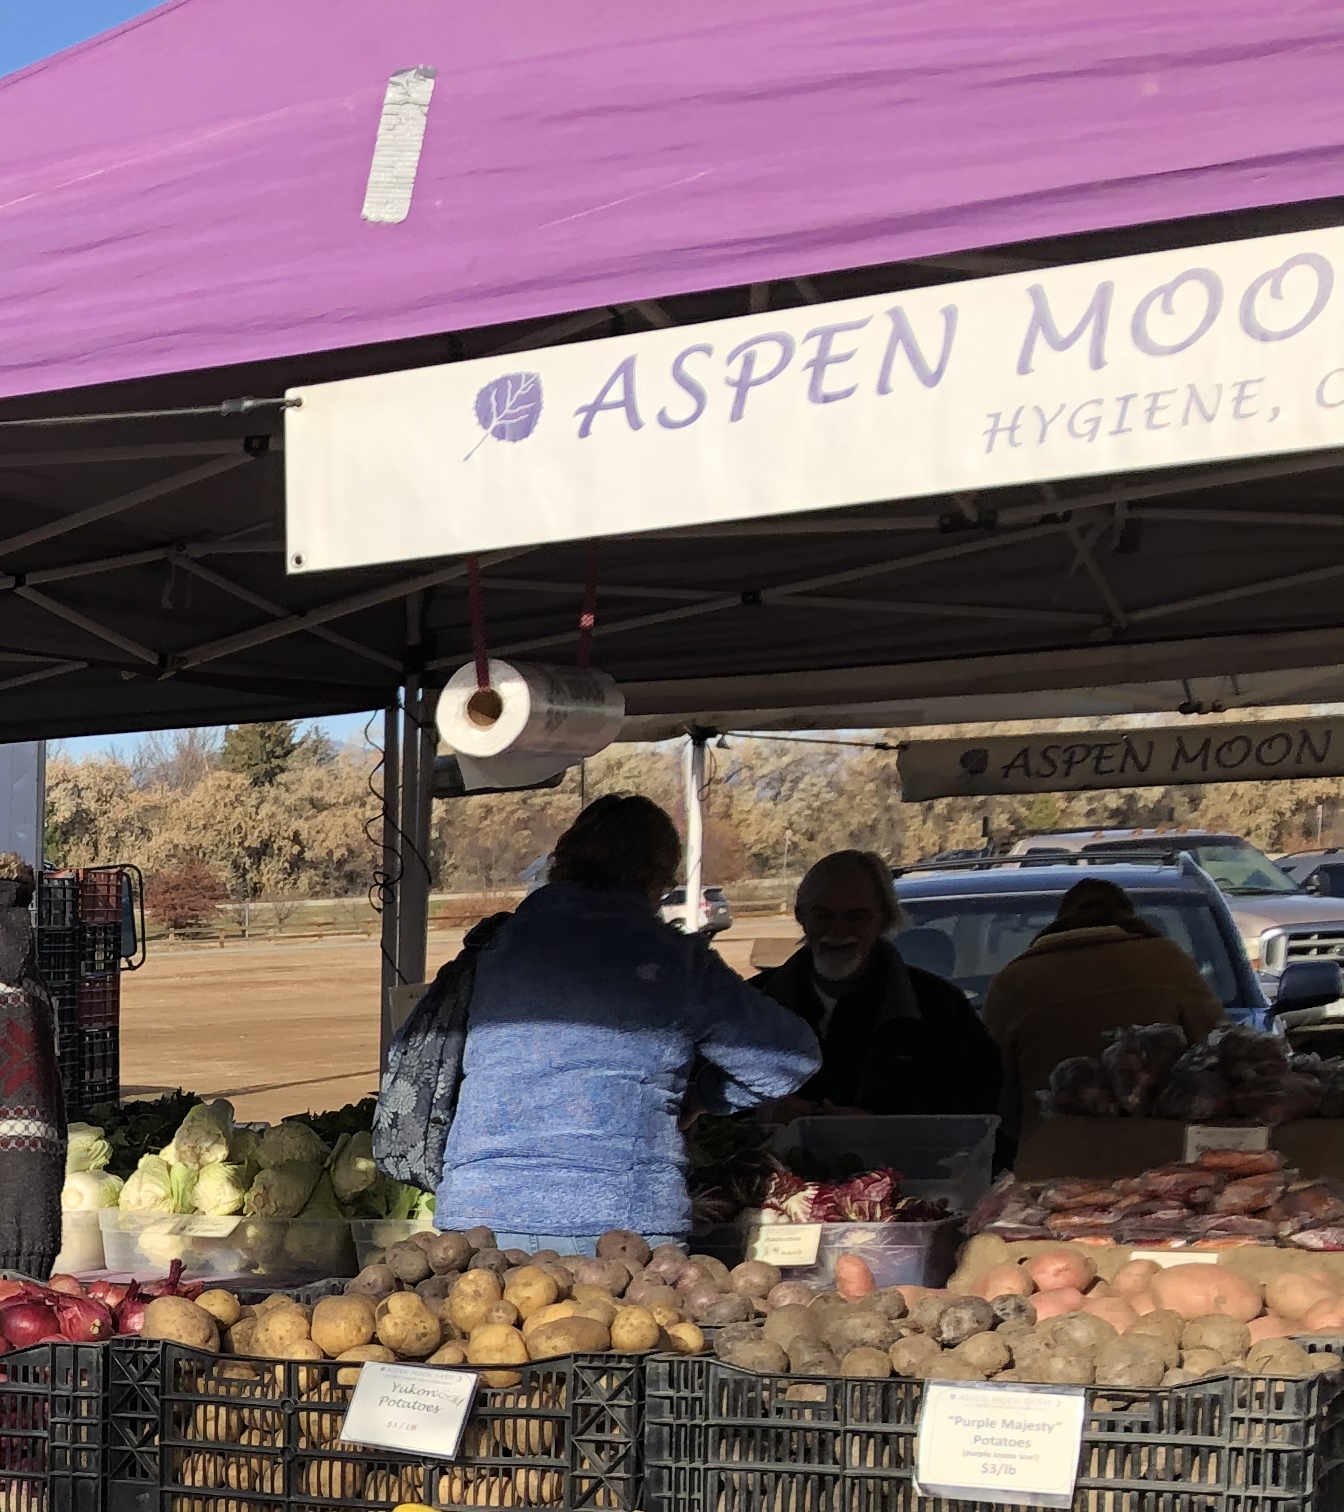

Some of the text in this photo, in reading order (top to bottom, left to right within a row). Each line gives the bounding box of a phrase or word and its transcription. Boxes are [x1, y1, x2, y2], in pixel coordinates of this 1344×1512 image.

[576, 302, 960, 440] ASPEN
[983, 379, 1282, 456] HYGIENE,
[1000, 728, 1333, 780] ASPEN MOON
[391, 1380, 437, 1398] Yukon
[378, 1395, 442, 1414] Potatoes
[973, 1434, 1032, 1449] Potatoes
[980, 1462, 1017, 1477] $3/lb
